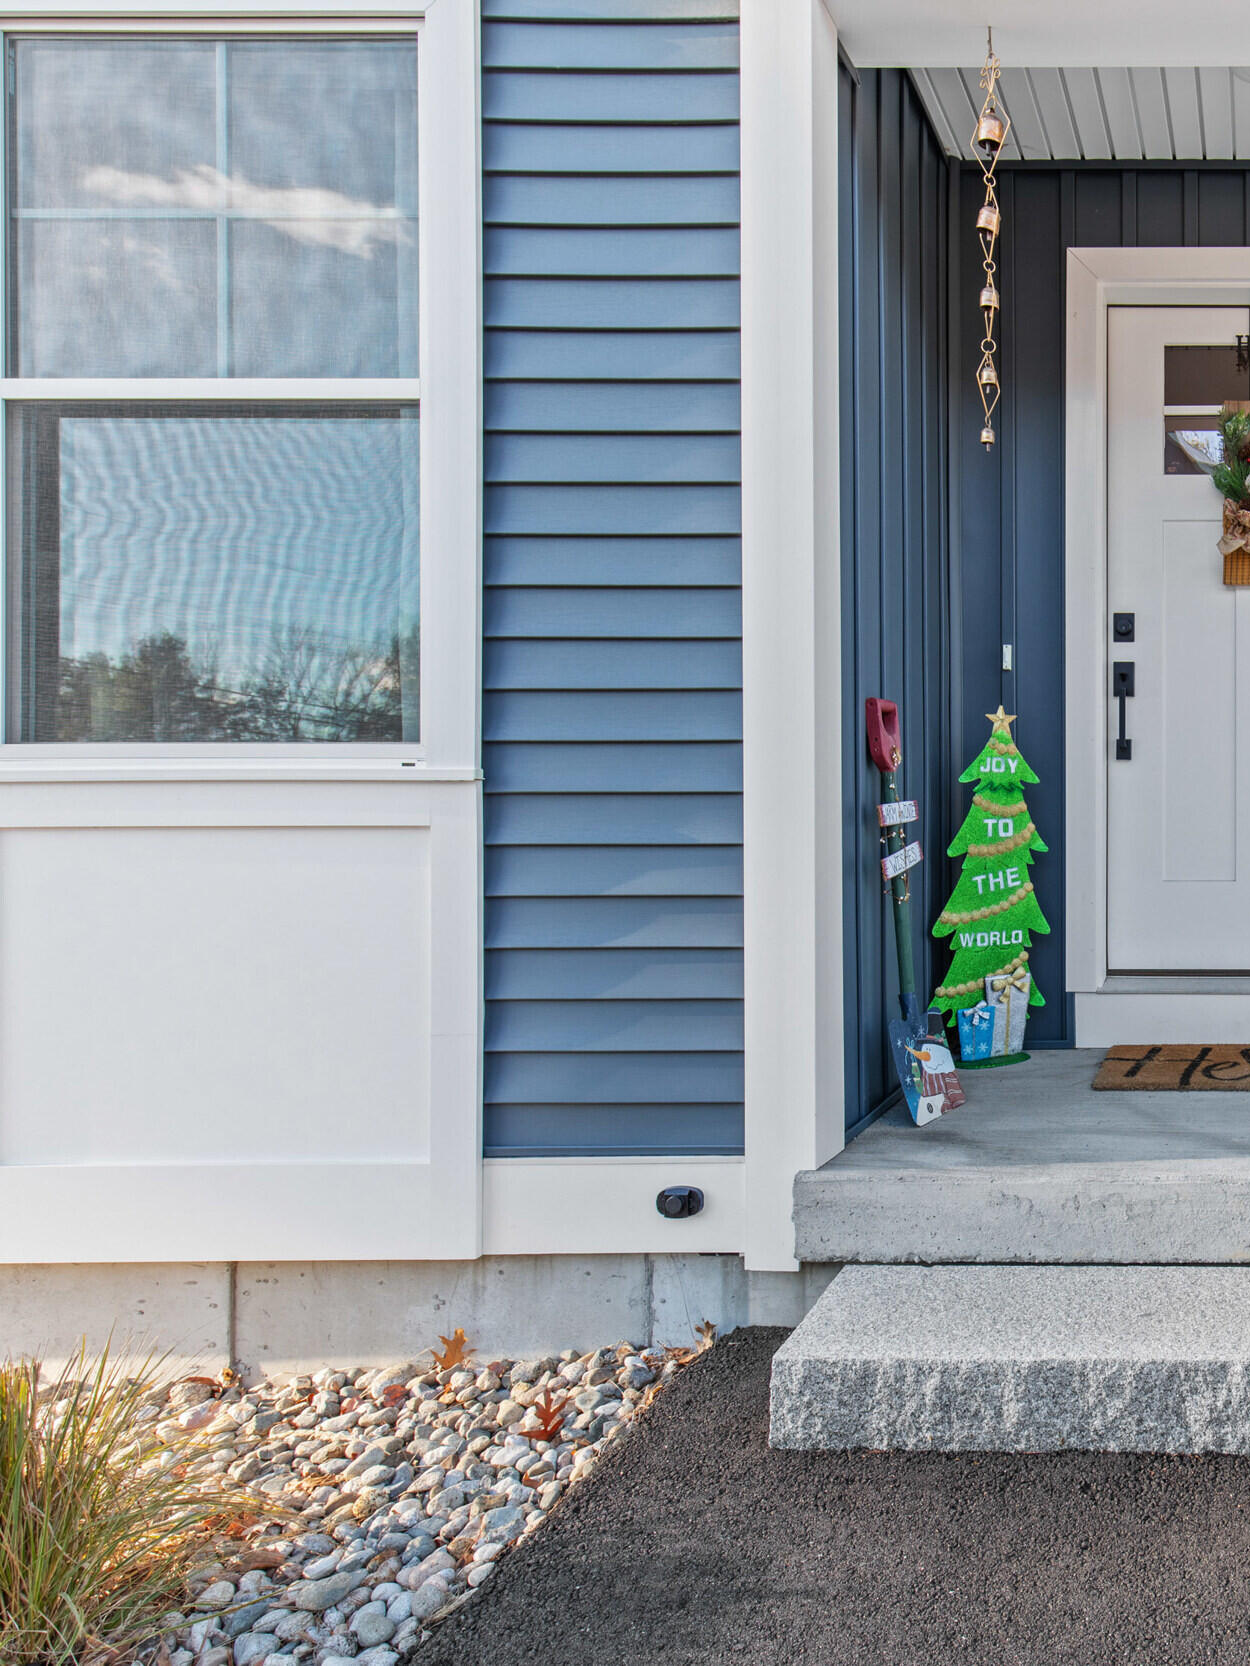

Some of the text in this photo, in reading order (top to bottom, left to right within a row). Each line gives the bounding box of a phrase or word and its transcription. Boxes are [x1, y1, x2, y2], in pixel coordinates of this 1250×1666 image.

[979, 757, 1018, 774] JOY
[983, 818, 1014, 838] TO
[972, 867, 1022, 895] THE
[959, 929, 1023, 948] WORLD
